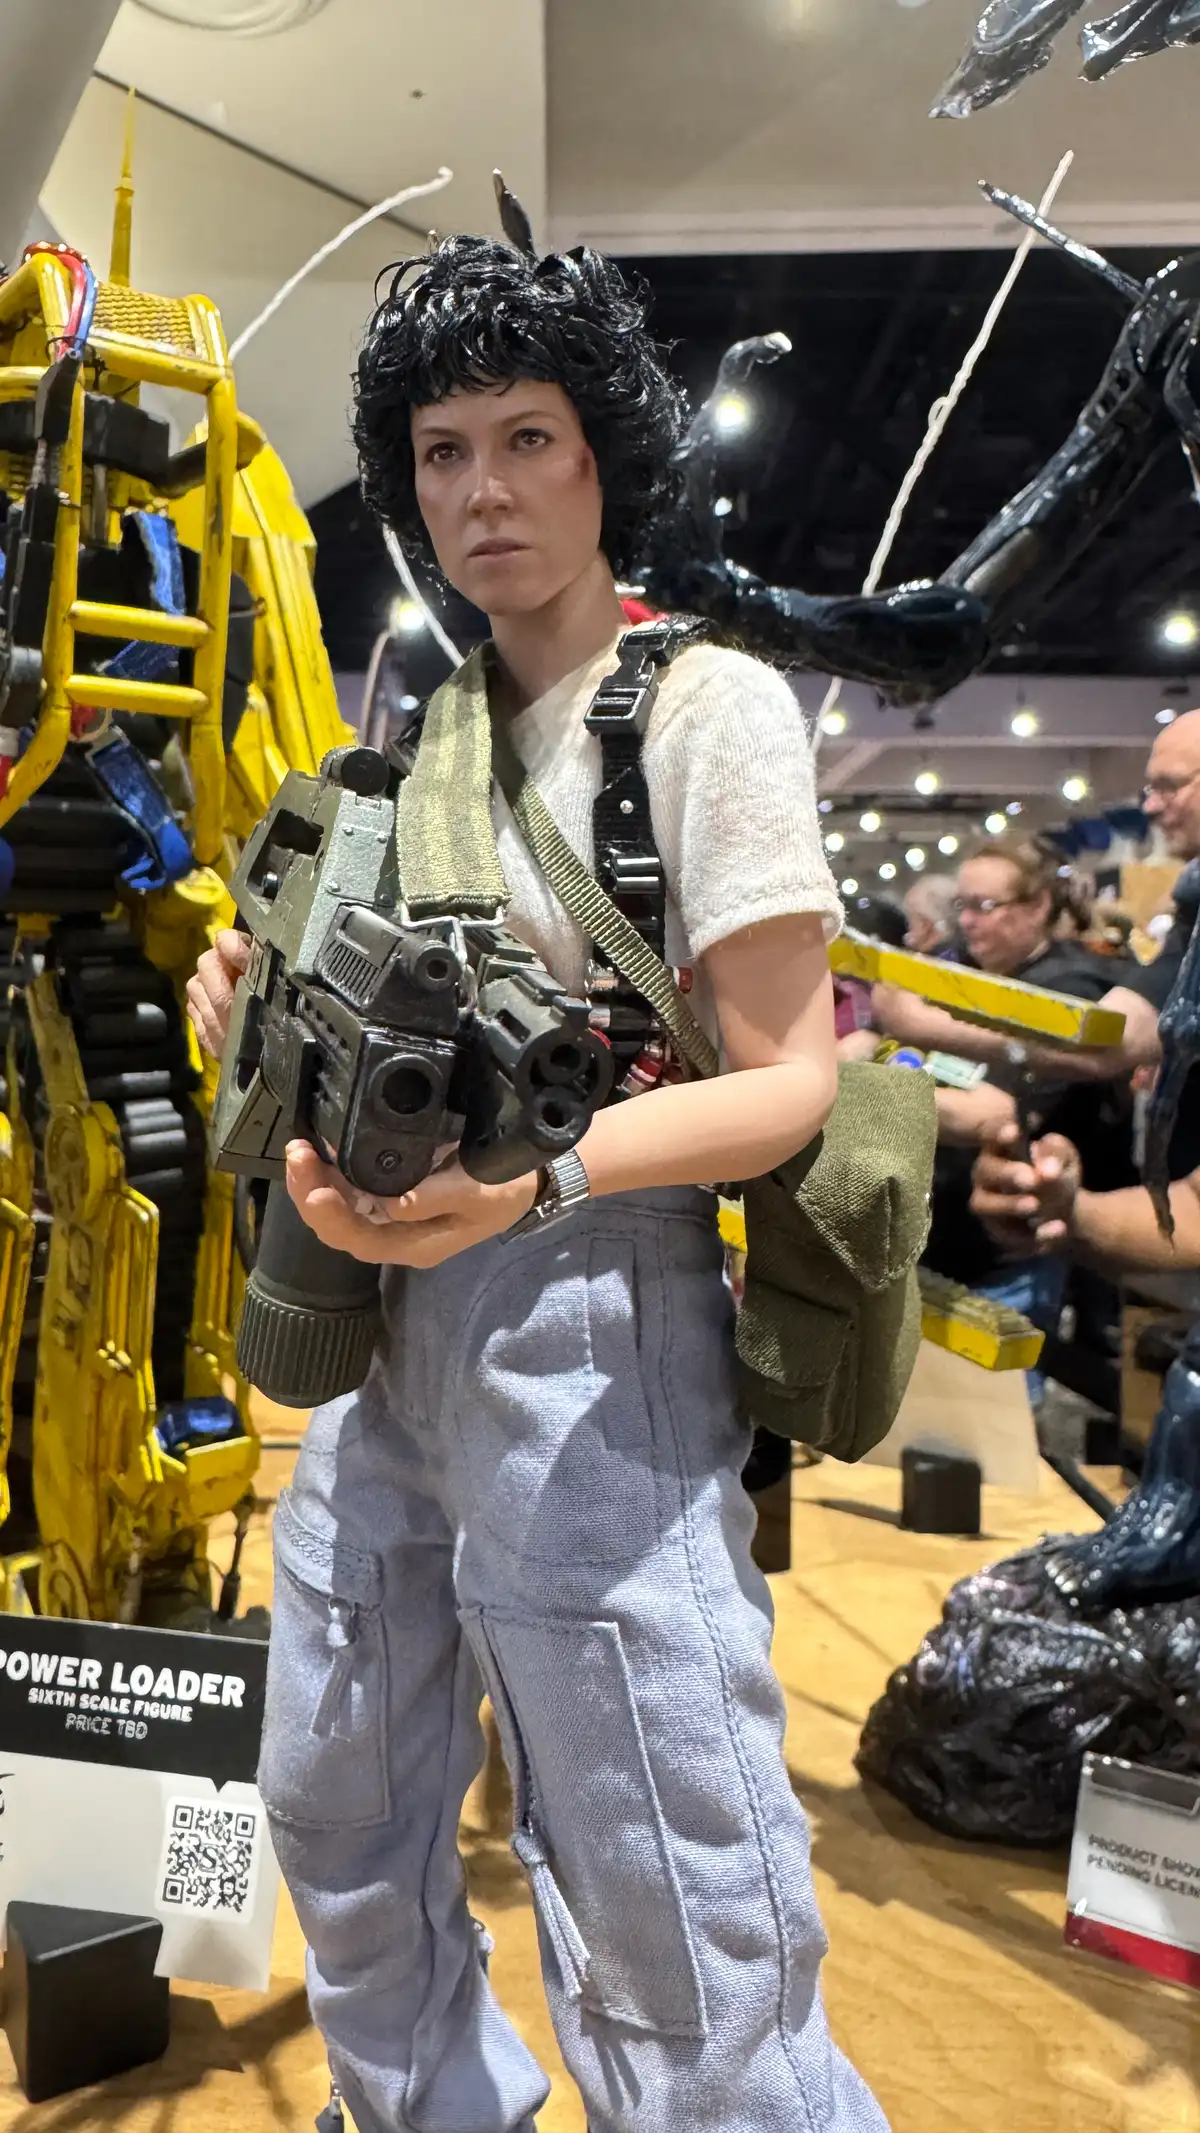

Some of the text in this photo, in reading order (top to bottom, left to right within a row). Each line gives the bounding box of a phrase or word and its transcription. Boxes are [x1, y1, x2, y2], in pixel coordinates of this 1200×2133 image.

[110, 1661, 246, 1708] LOADER
[28, 1687, 193, 1722] SIXTH SCALE FIGURE
[65, 1713, 148, 1740] PRICE TBD
[1088, 1833, 1158, 1866] PRODUCT
[1087, 1853, 1151, 1883] PENDING
